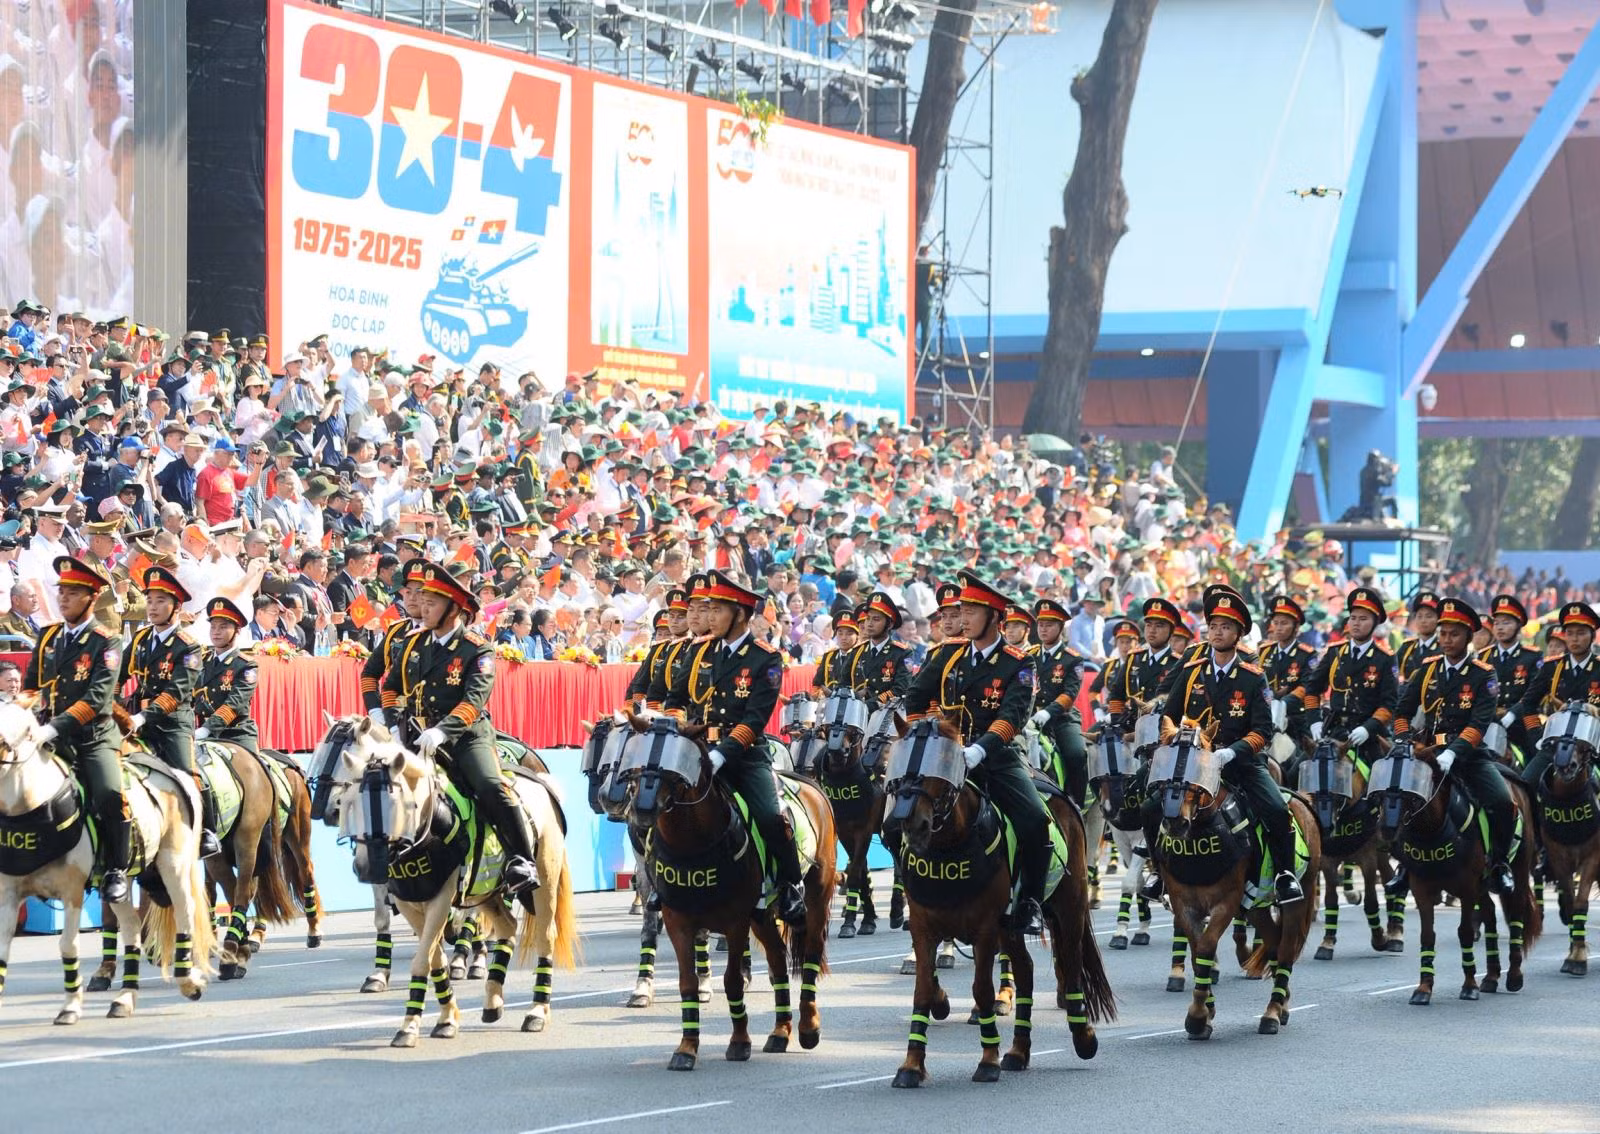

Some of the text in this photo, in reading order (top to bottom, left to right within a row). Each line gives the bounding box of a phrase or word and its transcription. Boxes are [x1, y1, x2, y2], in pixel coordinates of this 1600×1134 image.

[824, 784, 861, 800] OLICE
[1544, 803, 1594, 823] POLICE
[0, 827, 37, 850] LICE
[1331, 820, 1363, 837] LICE
[1165, 835, 1222, 855] POLICE
[1403, 841, 1456, 862] POLICE
[388, 856, 433, 879] LICE
[655, 860, 718, 888] POLICE
[907, 852, 971, 880] POLICE
